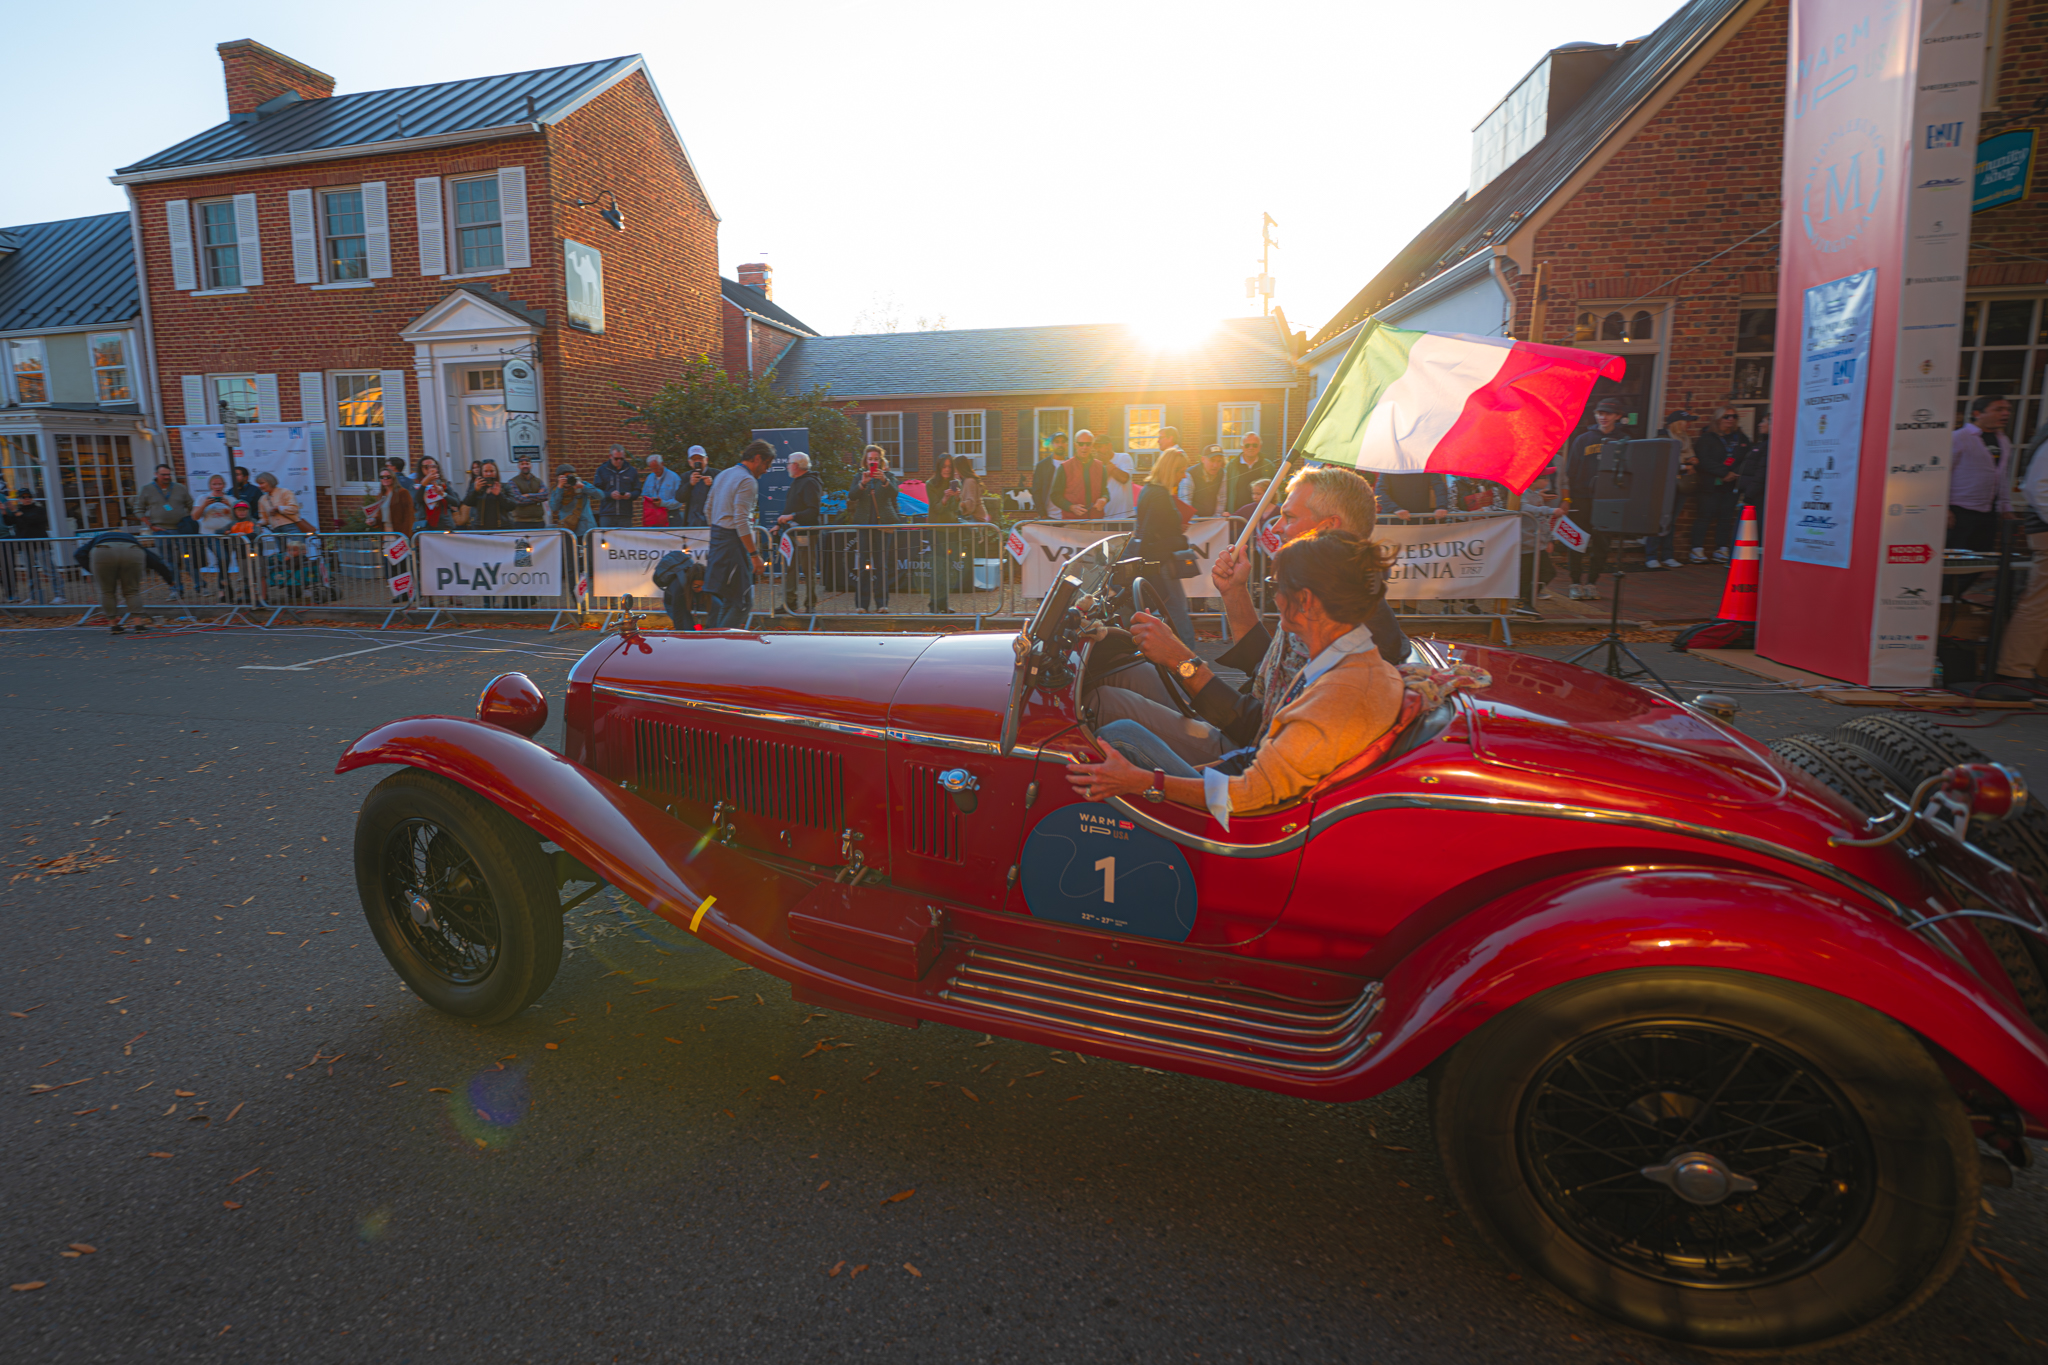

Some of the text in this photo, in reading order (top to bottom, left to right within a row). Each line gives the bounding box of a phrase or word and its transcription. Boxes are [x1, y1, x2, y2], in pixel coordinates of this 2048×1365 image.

[437, 562, 550, 590] PLAYroom
[1079, 812, 1116, 827] WARM
[1080, 824, 1111, 835] UP
[1113, 830, 1129, 841] USA
[1095, 856, 1115, 904] 1
